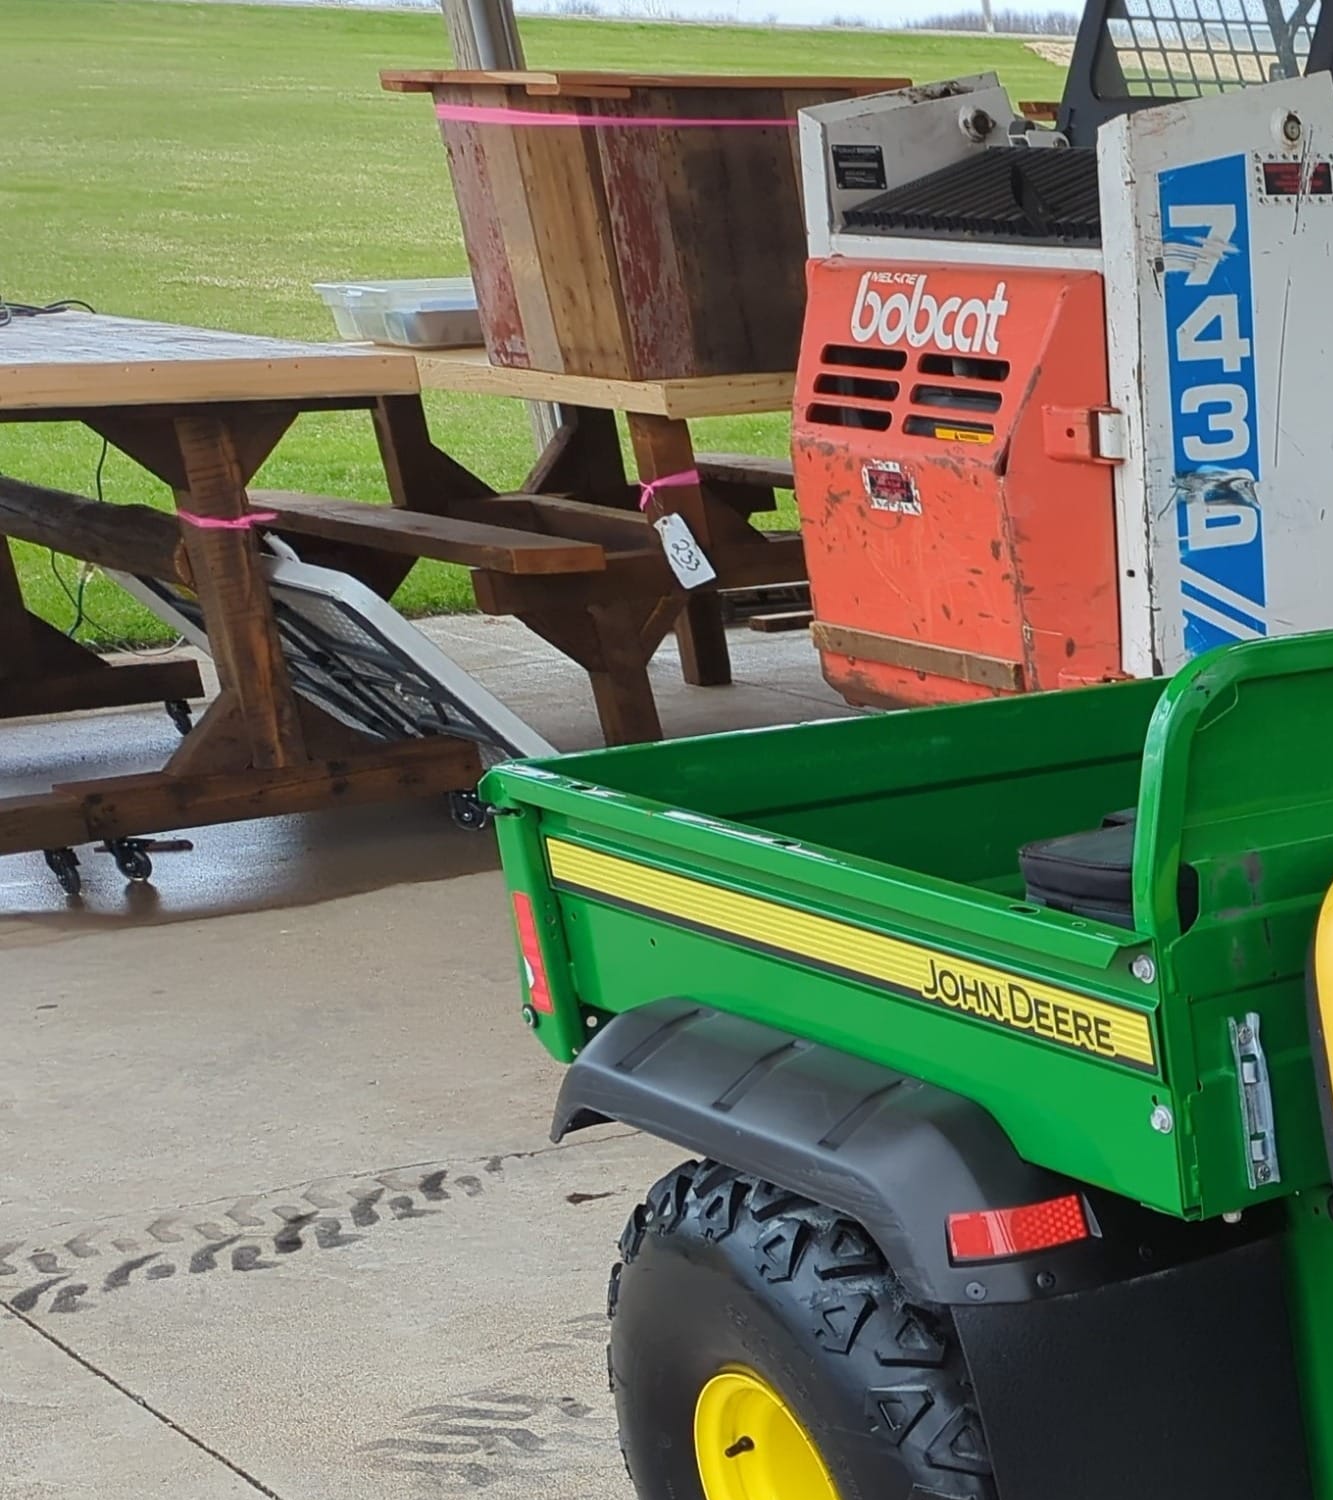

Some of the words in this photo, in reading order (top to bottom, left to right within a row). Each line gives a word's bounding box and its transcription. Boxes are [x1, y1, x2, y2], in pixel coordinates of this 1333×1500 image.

[851, 271, 1009, 355] bobcat
[671, 538, 701, 572] 233
[923, 958, 1004, 1017] JOHN
[1007, 982, 1115, 1052] DEERE
